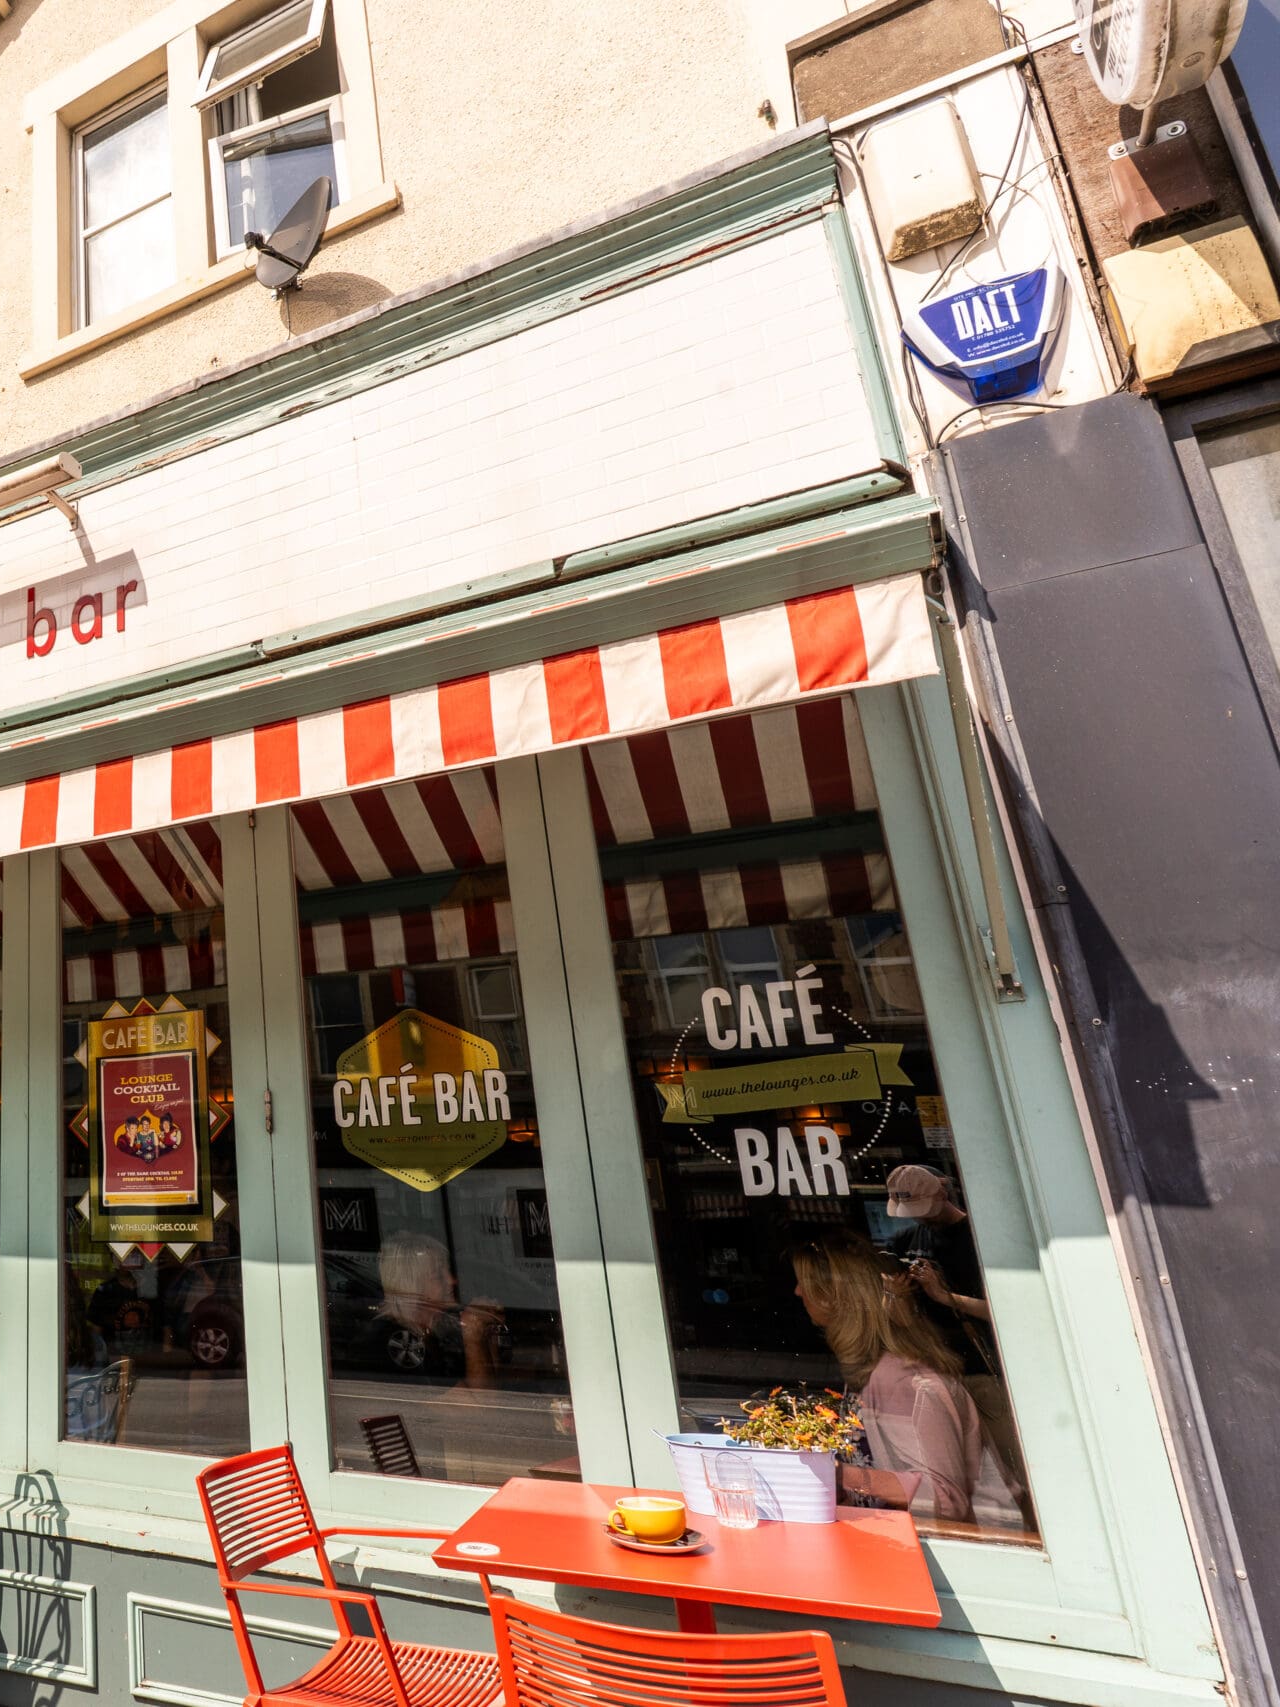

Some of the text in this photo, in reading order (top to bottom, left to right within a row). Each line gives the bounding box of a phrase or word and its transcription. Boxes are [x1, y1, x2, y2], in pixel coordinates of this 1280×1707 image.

[950, 284, 1021, 341] DACT
[26, 579, 138, 659] bar
[701, 963, 834, 1050] CAFÉ
[103, 1021, 189, 1050] CAFÉ BAR
[113, 1083, 180, 1095] COCKTAIL
[121, 1073, 173, 1085] LOUNGE
[130, 1094, 165, 1104] CLUB
[333, 1062, 512, 1128] CAFÉ BAR
[701, 1067, 862, 1100] www.thelounges.co.uk
[734, 1126, 850, 1197] BAR
